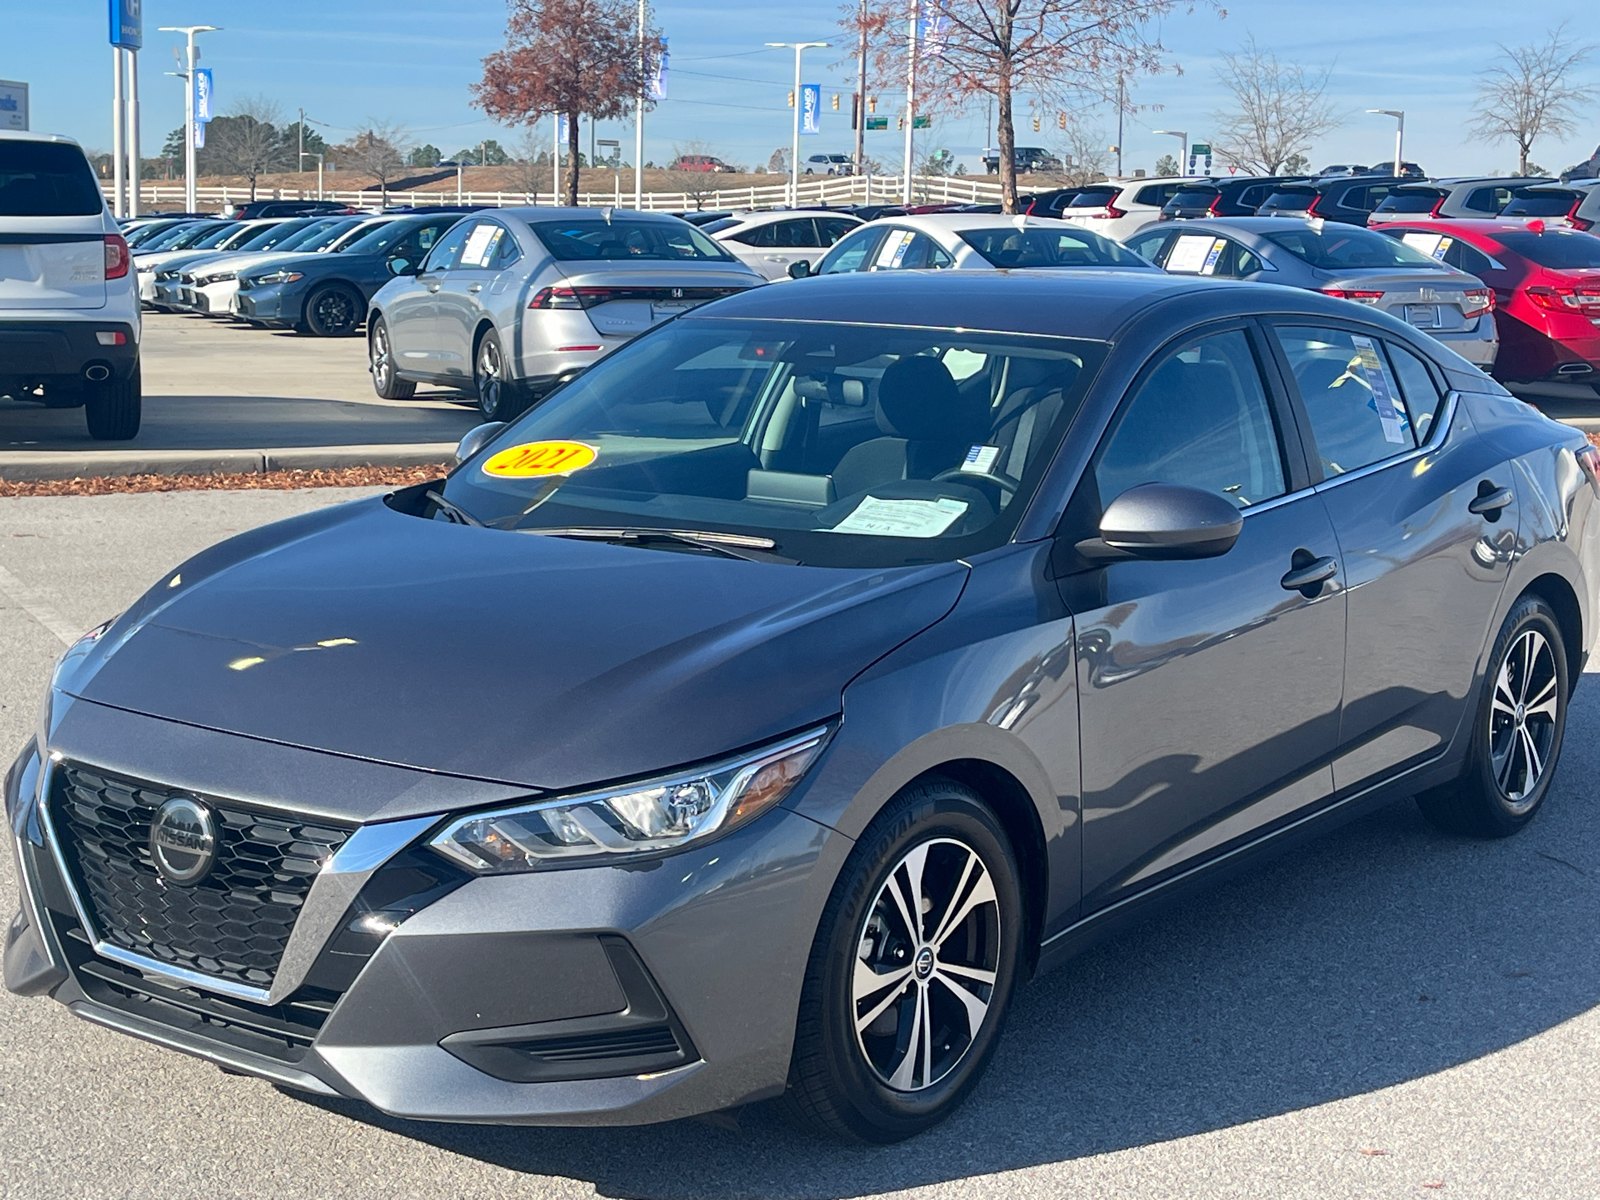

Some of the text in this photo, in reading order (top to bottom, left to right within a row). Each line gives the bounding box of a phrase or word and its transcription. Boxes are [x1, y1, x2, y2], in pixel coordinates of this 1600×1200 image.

[804, 87, 812, 130] MIDLANDS
[494, 448, 582, 469] 2021
[156, 828, 205, 852] NISSAN
[845, 810, 917, 919] UNIROYAL
